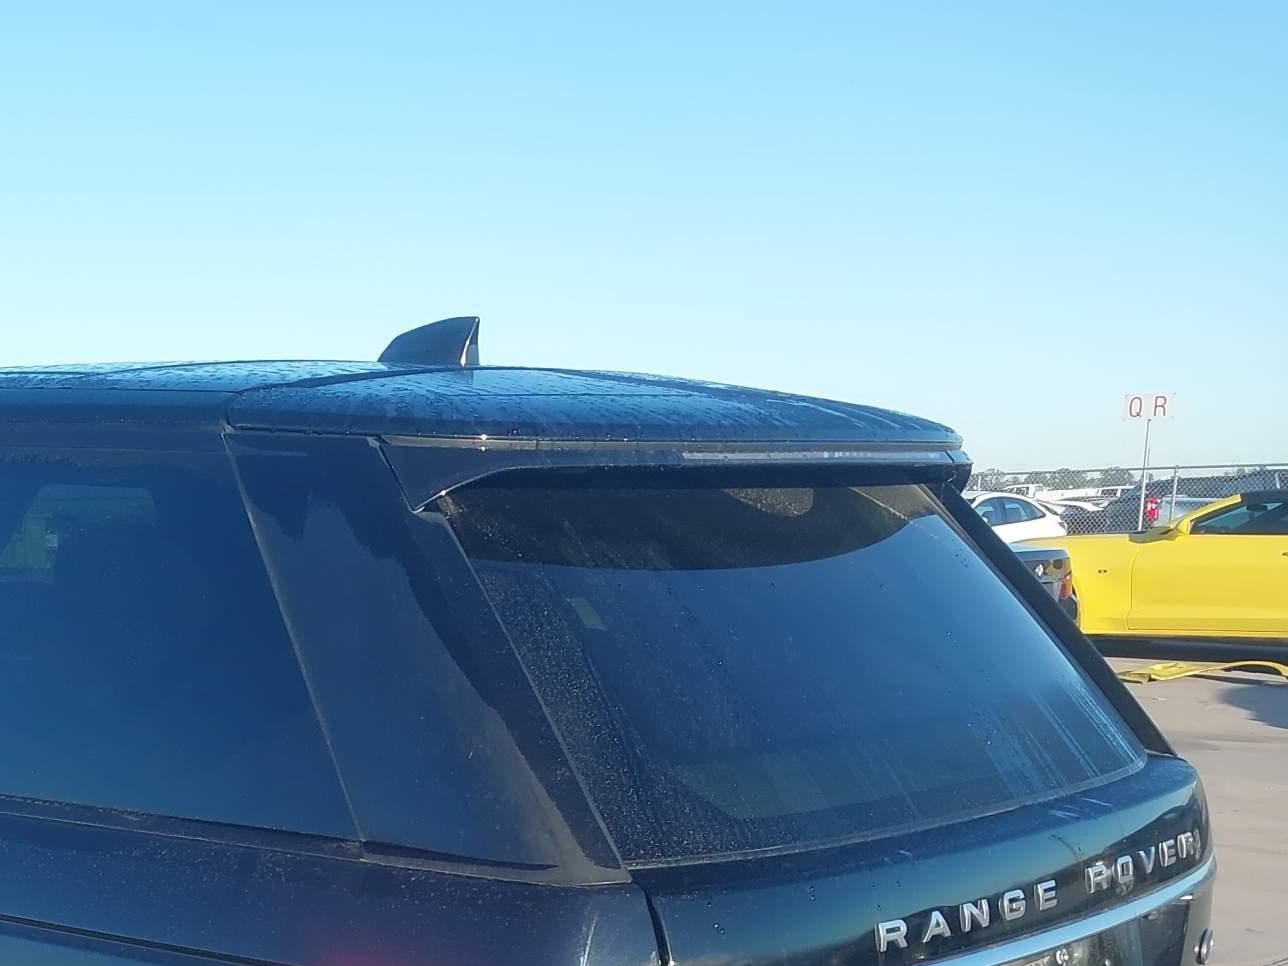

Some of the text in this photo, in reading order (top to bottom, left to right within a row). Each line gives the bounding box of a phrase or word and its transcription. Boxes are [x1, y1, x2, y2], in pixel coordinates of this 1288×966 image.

[1129, 395, 1167, 418] Q R
[875, 829, 1198, 953] RANGE ROVER
